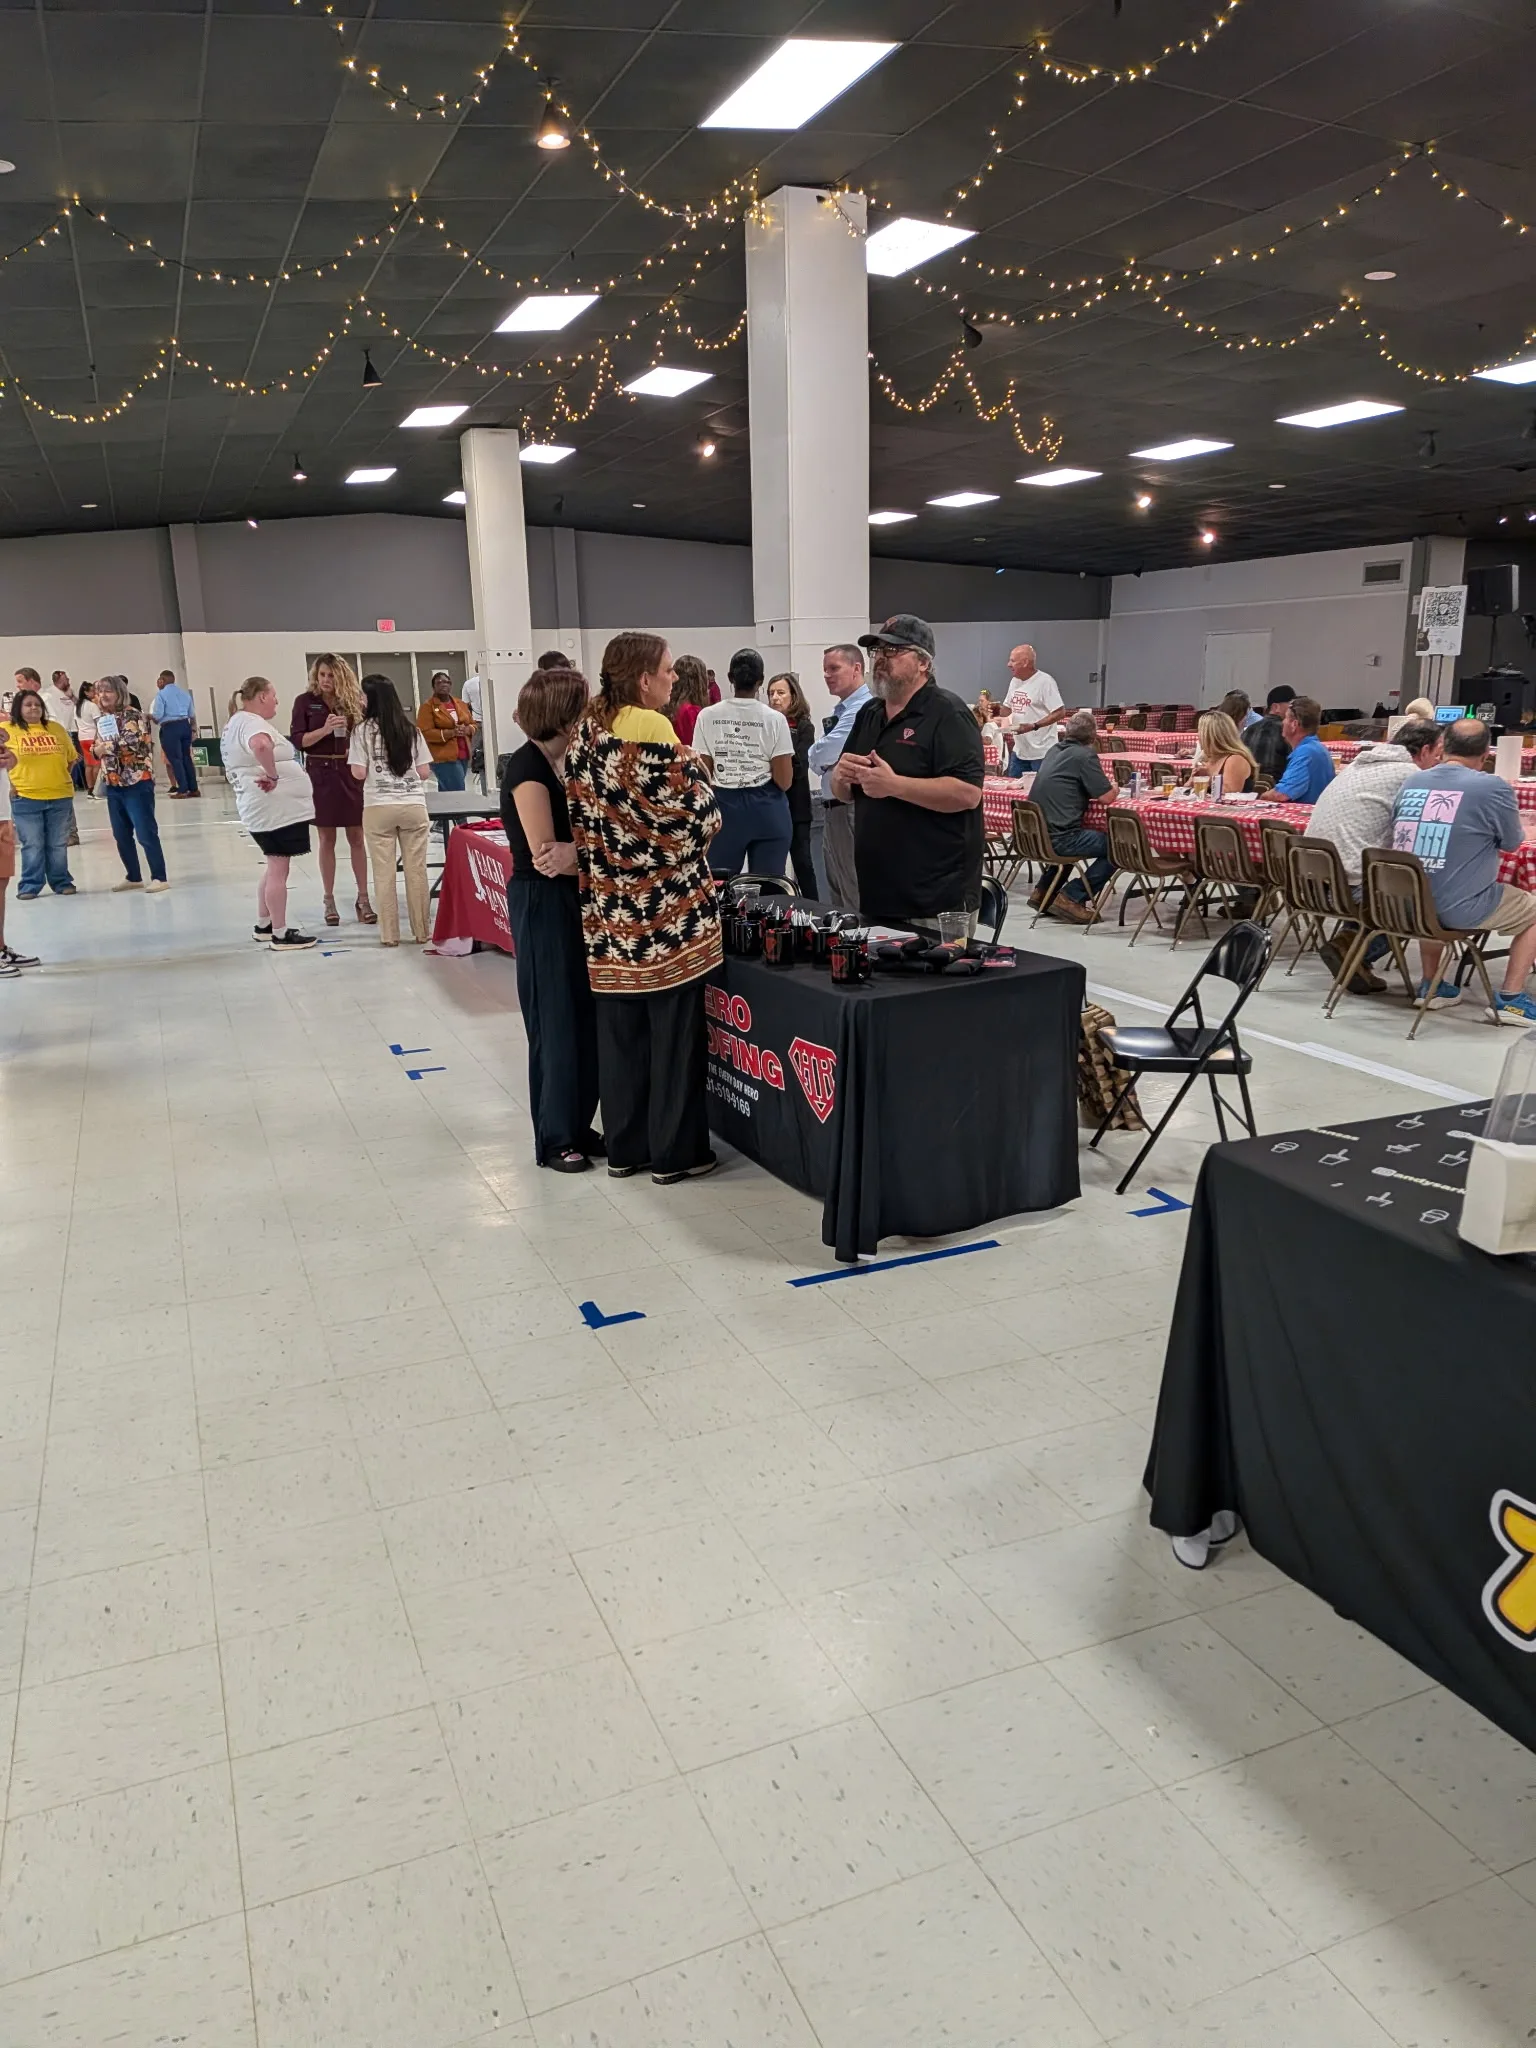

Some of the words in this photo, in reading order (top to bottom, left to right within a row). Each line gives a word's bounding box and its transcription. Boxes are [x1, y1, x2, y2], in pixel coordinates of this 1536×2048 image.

[707, 1061, 718, 1076] THE
[718, 1066, 732, 1086] EVERY
[732, 1076, 744, 1093] DAY
[743, 1083, 760, 1102] HERO
